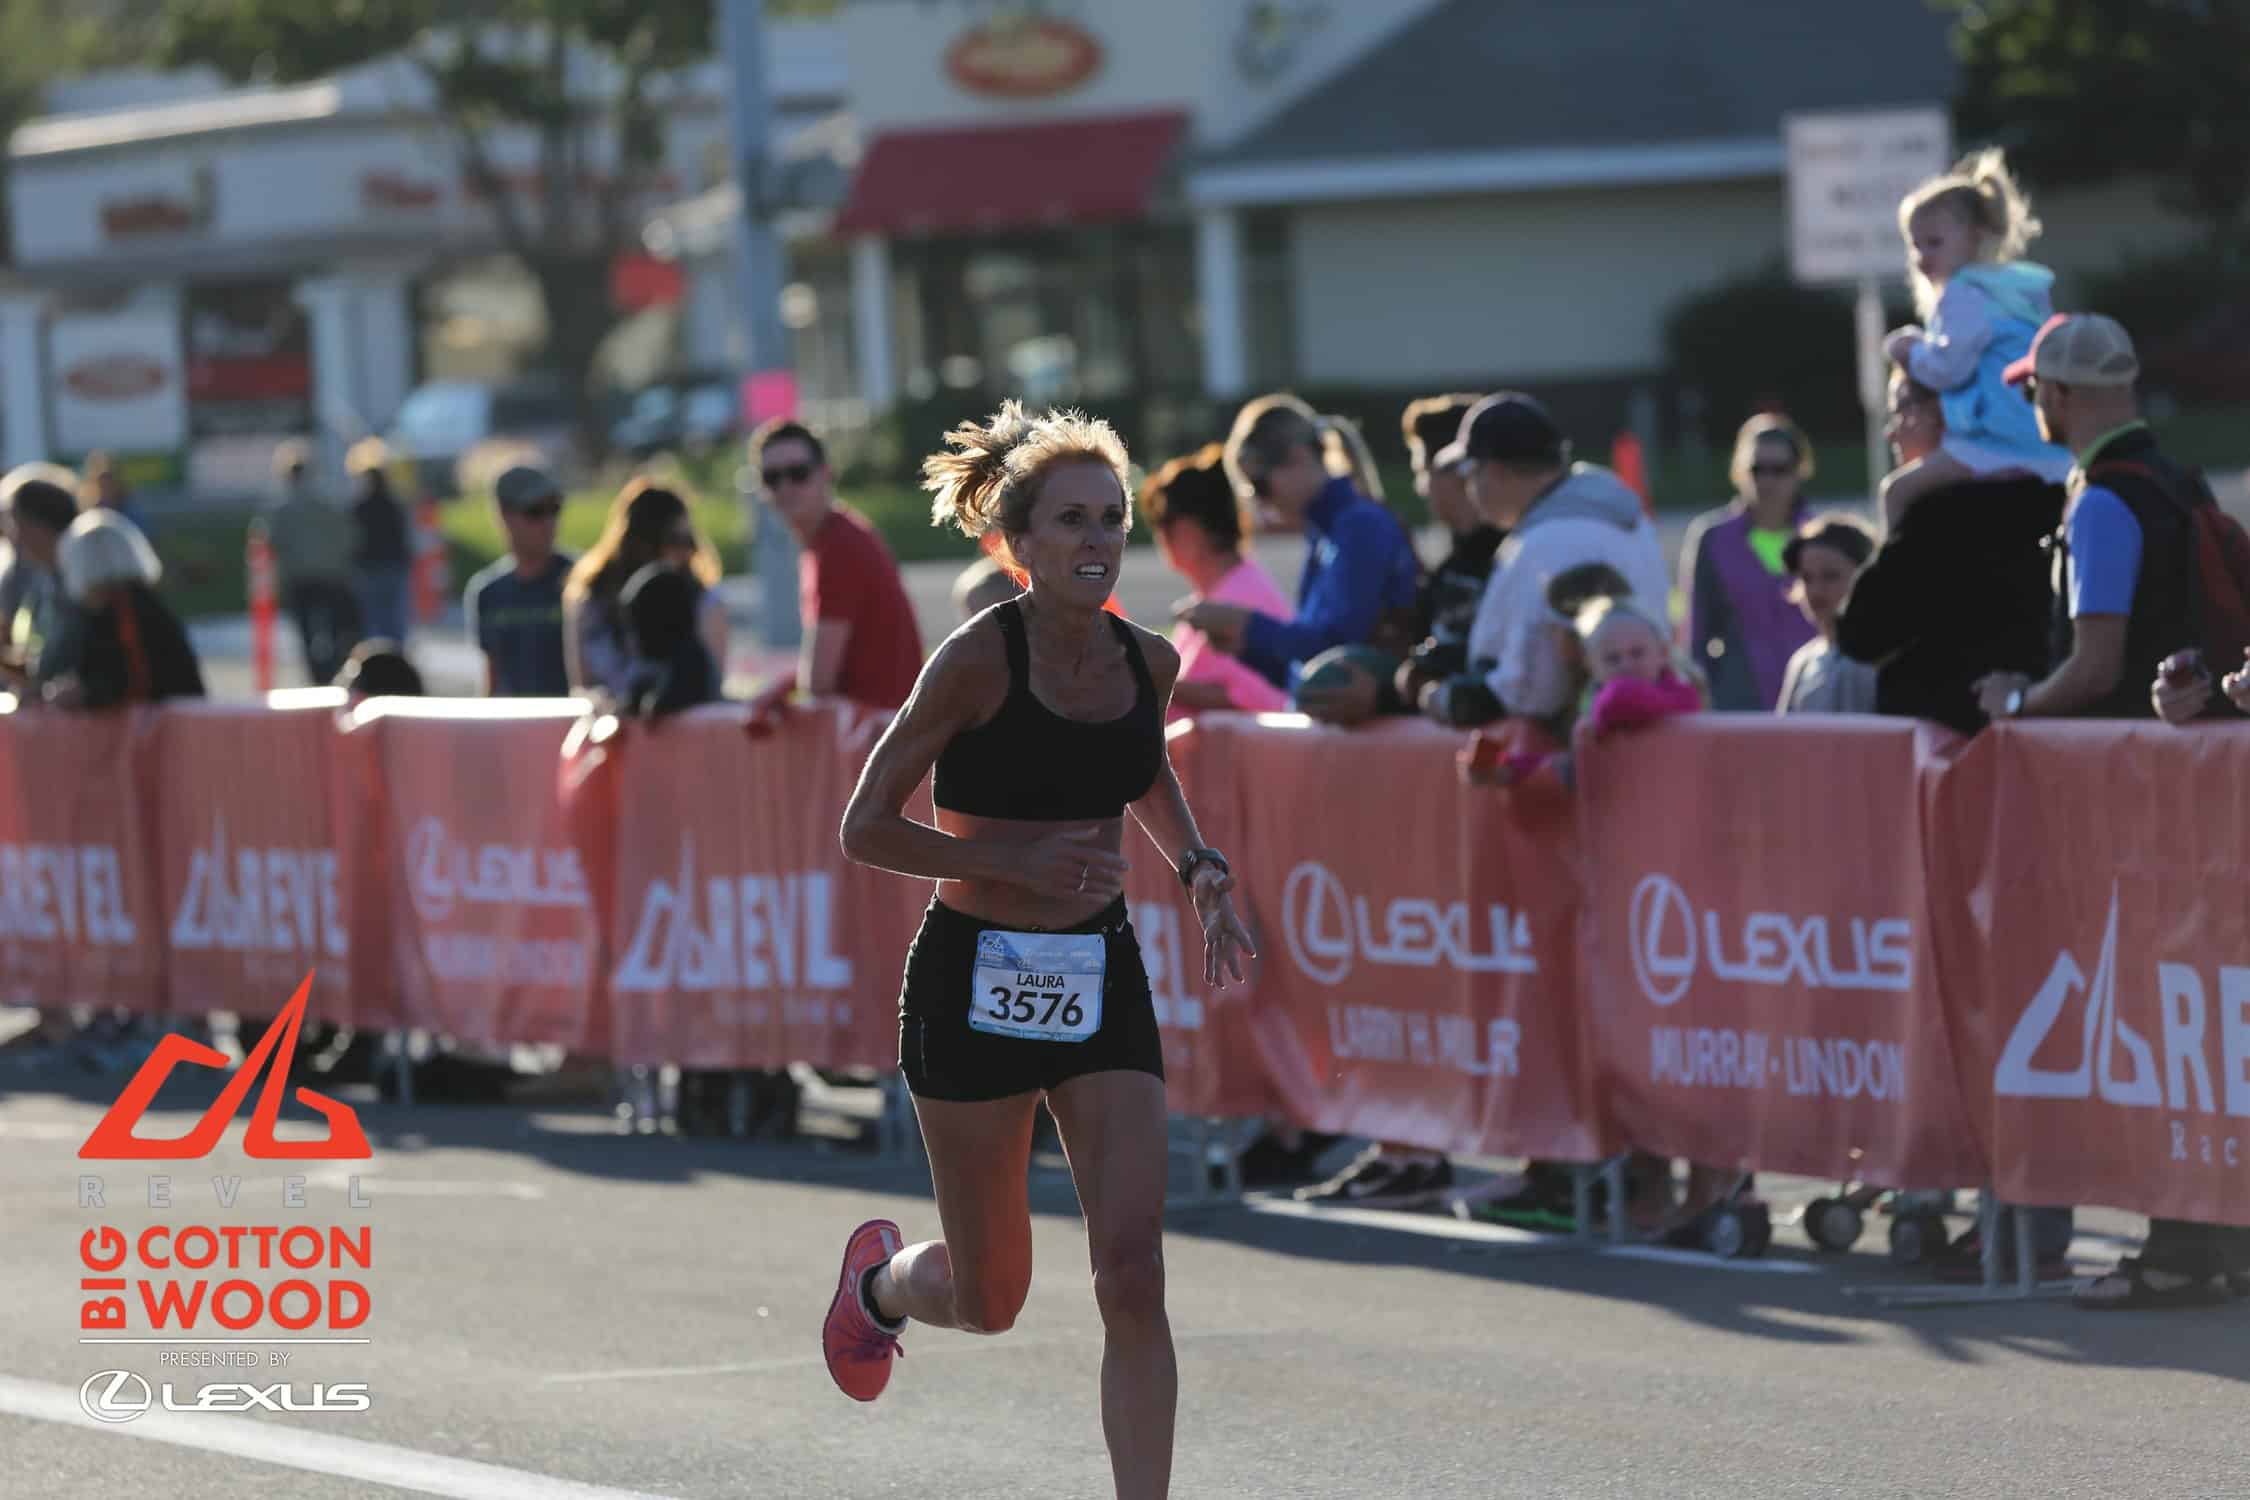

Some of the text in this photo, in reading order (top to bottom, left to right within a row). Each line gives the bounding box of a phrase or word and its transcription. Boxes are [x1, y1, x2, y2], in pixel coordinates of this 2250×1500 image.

[1704, 911, 1912, 991] LEXUS
[1016, 973, 1065, 988] LAURA
[989, 986, 1084, 1027] 3576
